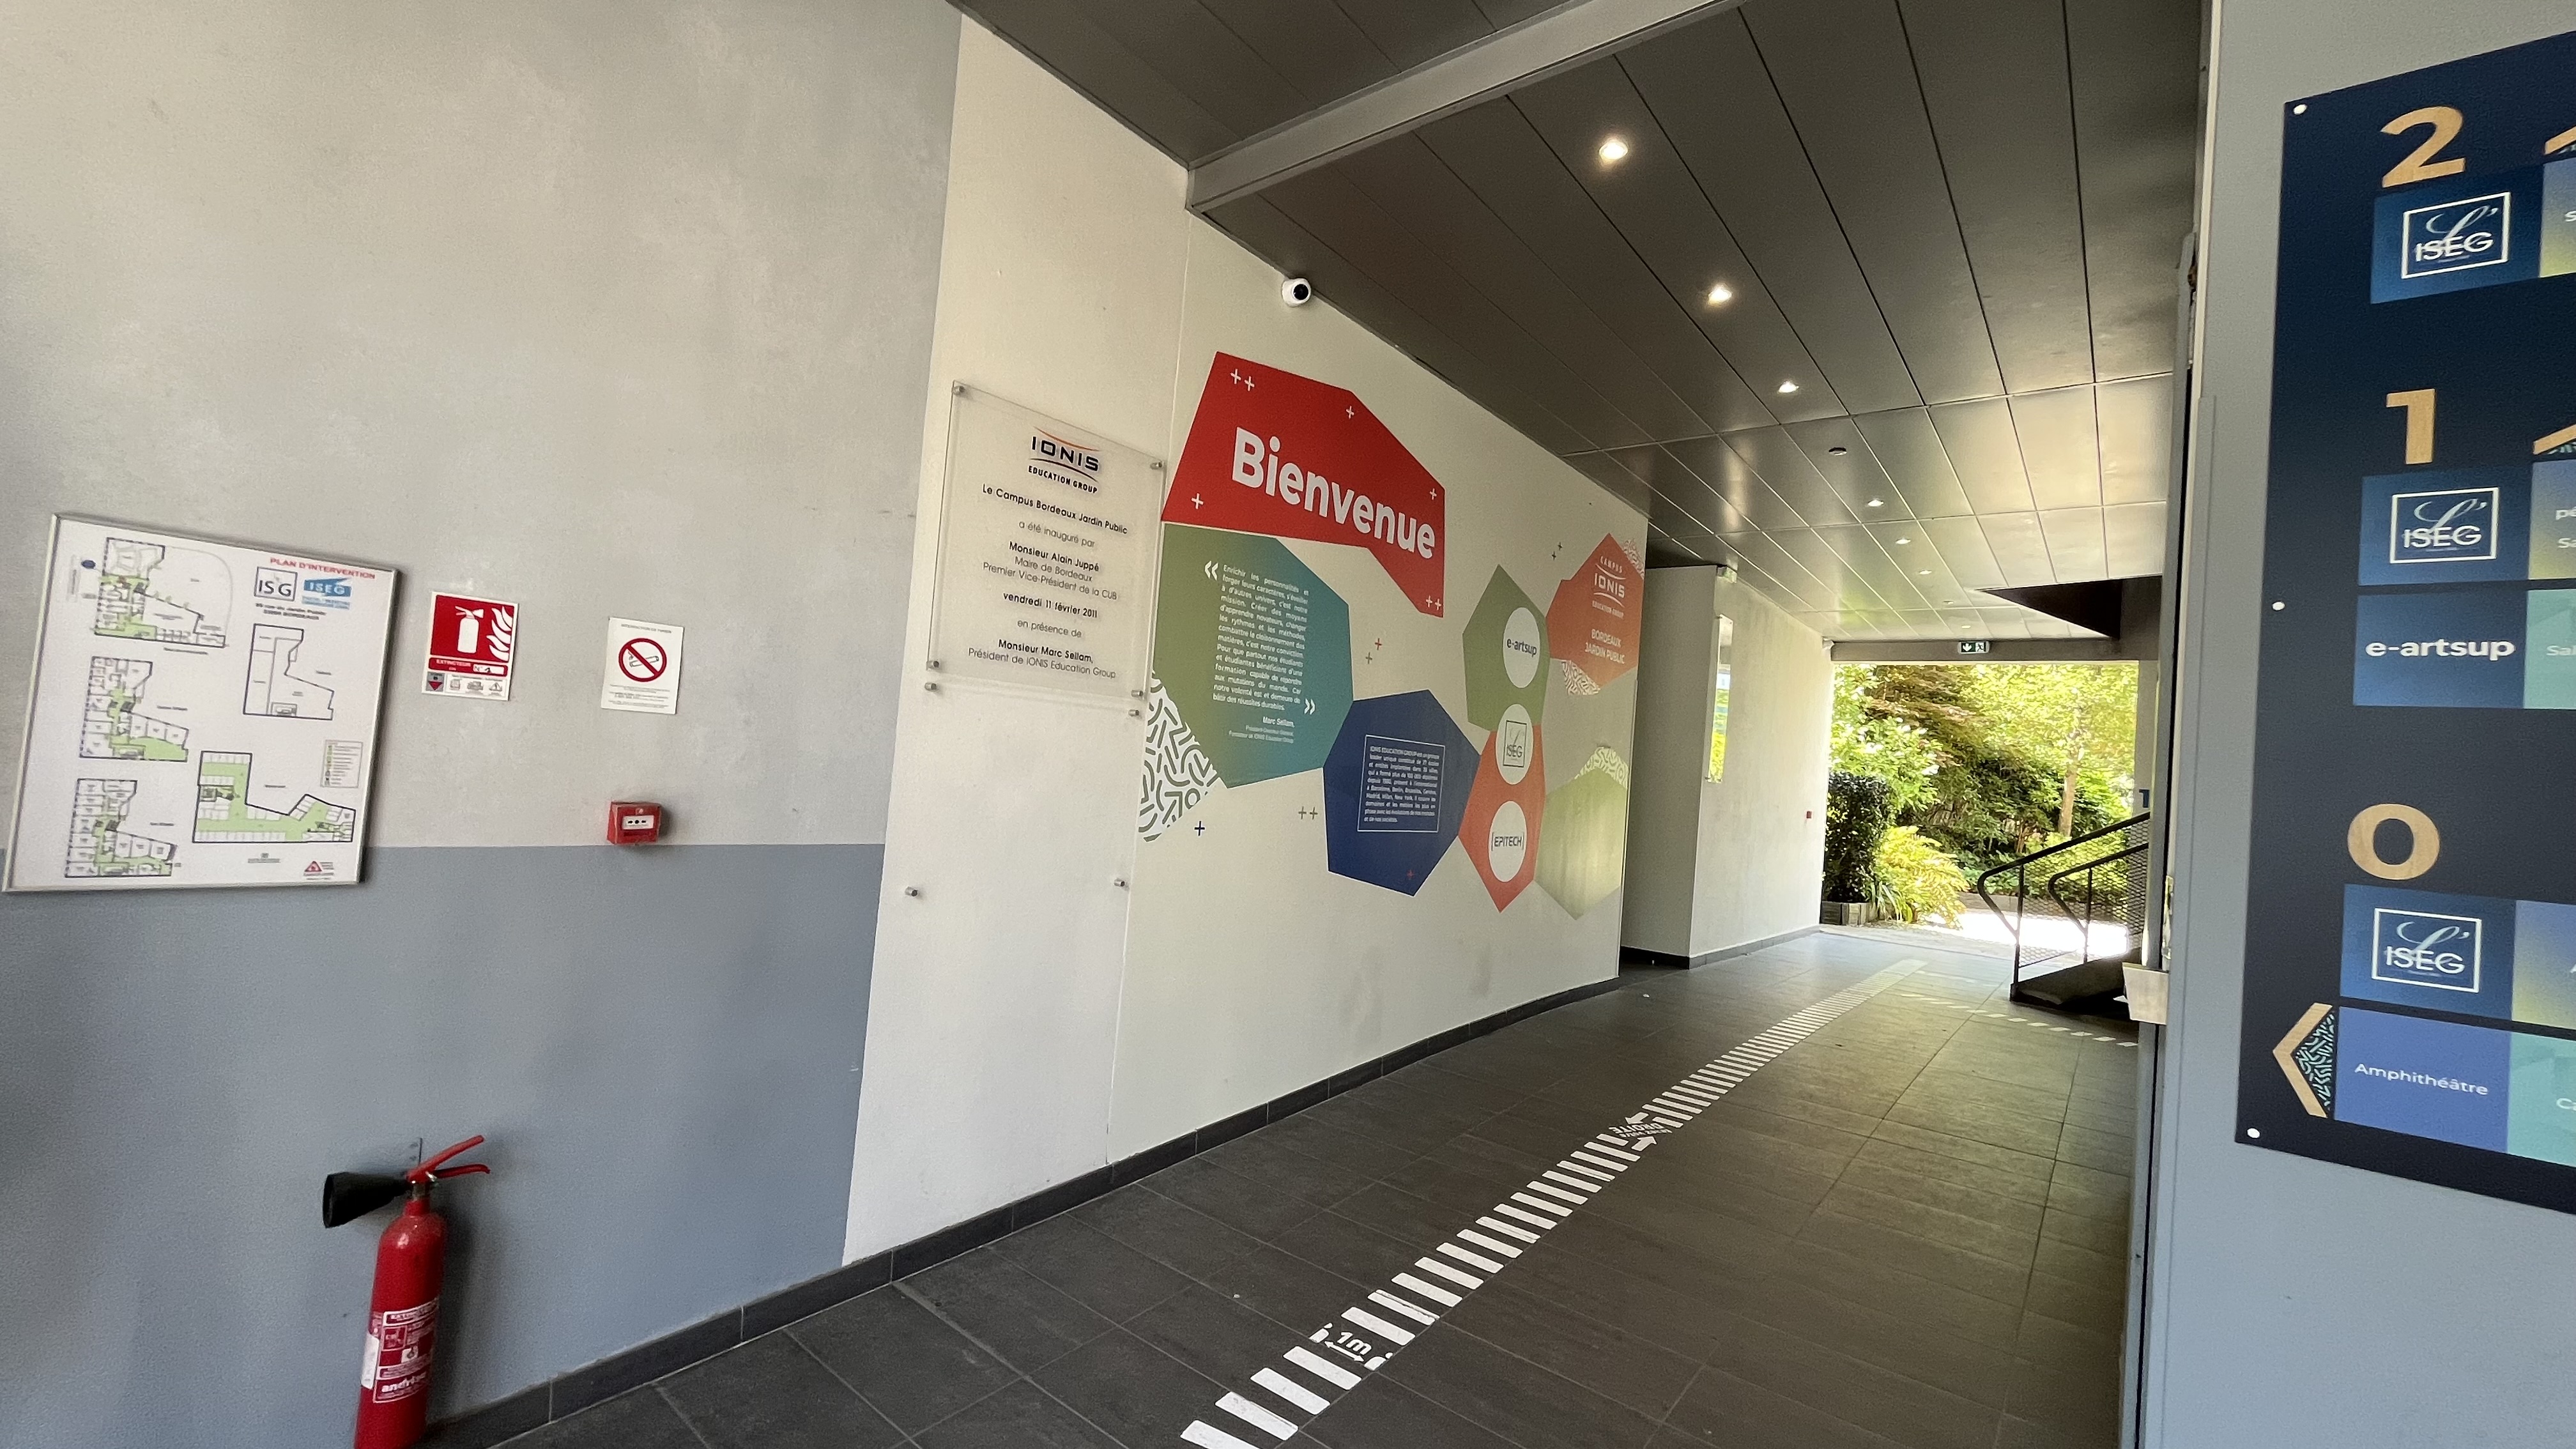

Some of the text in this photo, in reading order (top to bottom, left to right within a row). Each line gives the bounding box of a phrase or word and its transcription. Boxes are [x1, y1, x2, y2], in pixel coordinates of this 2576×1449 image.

[2380, 106, 2465, 188] 2
[2415, 232, 2494, 262] ISEG
[2386, 388, 2435, 464] 1
[1031, 436, 1099, 471] IONIS
[1028, 465, 1098, 494] EDUCATION GROUP
[1232, 426, 1435, 558] Bienvenue
[982, 484, 1128, 534] Le Campus Bordeaux Jardin Public
[1027, 521, 1041, 533] été
[1043, 526, 1079, 543] inauguré
[1081, 539, 1095, 548] par
[2404, 525, 2482, 548] ISEG
[270, 557, 376, 579] PLAN D'INTERVENTION
[1009, 541, 1100, 572] Monsieur Alain Juppé
[1015, 556, 1092, 582] Maire de Bordeaux
[259, 580, 292, 597] ISG
[310, 582, 345, 595] ISEG
[983, 562, 1117, 601] Premier Vice-Président de la CUB
[1594, 572, 1625, 598] IONIS
[1003, 592, 1098, 618] vendredi 11 février 2011
[1017, 620, 1082, 638] en présence de
[1591, 628, 1621, 648] BORDEAUX
[998, 640, 1094, 664] Monsieur Marc Sellam,
[1506, 638, 1537, 658] e-artsup
[1584, 642, 1606, 658] JARDIN
[2365, 639, 2516, 661] e-artsup
[968, 647, 1116, 680] Président de IONIS Education Group
[2386, 946, 2465, 974] ISEG
[2354, 1063, 2488, 1096] Amphithéâtre
[1608, 1123, 1665, 1134] DROITE
[1337, 1331, 1372, 1355] 1m
